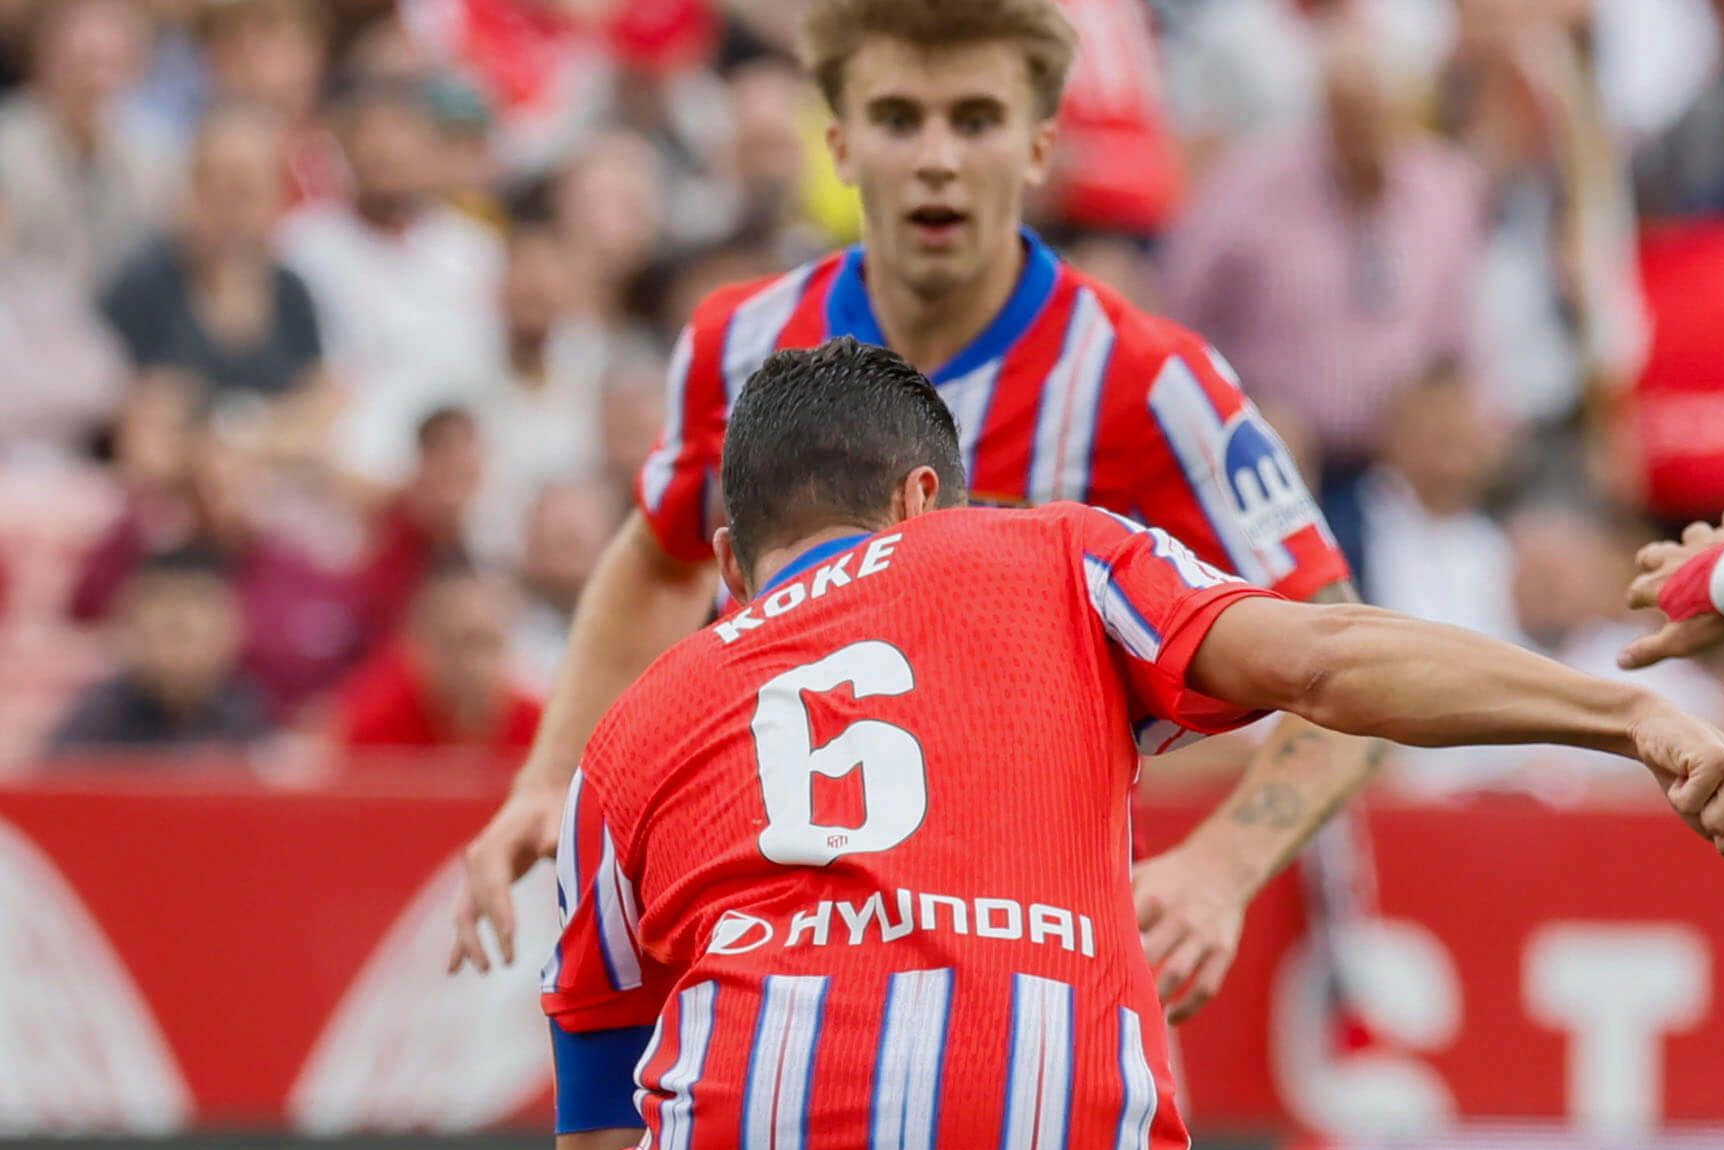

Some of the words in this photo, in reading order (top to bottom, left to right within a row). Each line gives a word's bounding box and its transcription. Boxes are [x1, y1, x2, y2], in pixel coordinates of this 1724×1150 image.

[714, 532, 903, 645] KOKE
[750, 640, 928, 866] 6
[784, 888, 1096, 958] HYUNDAI
